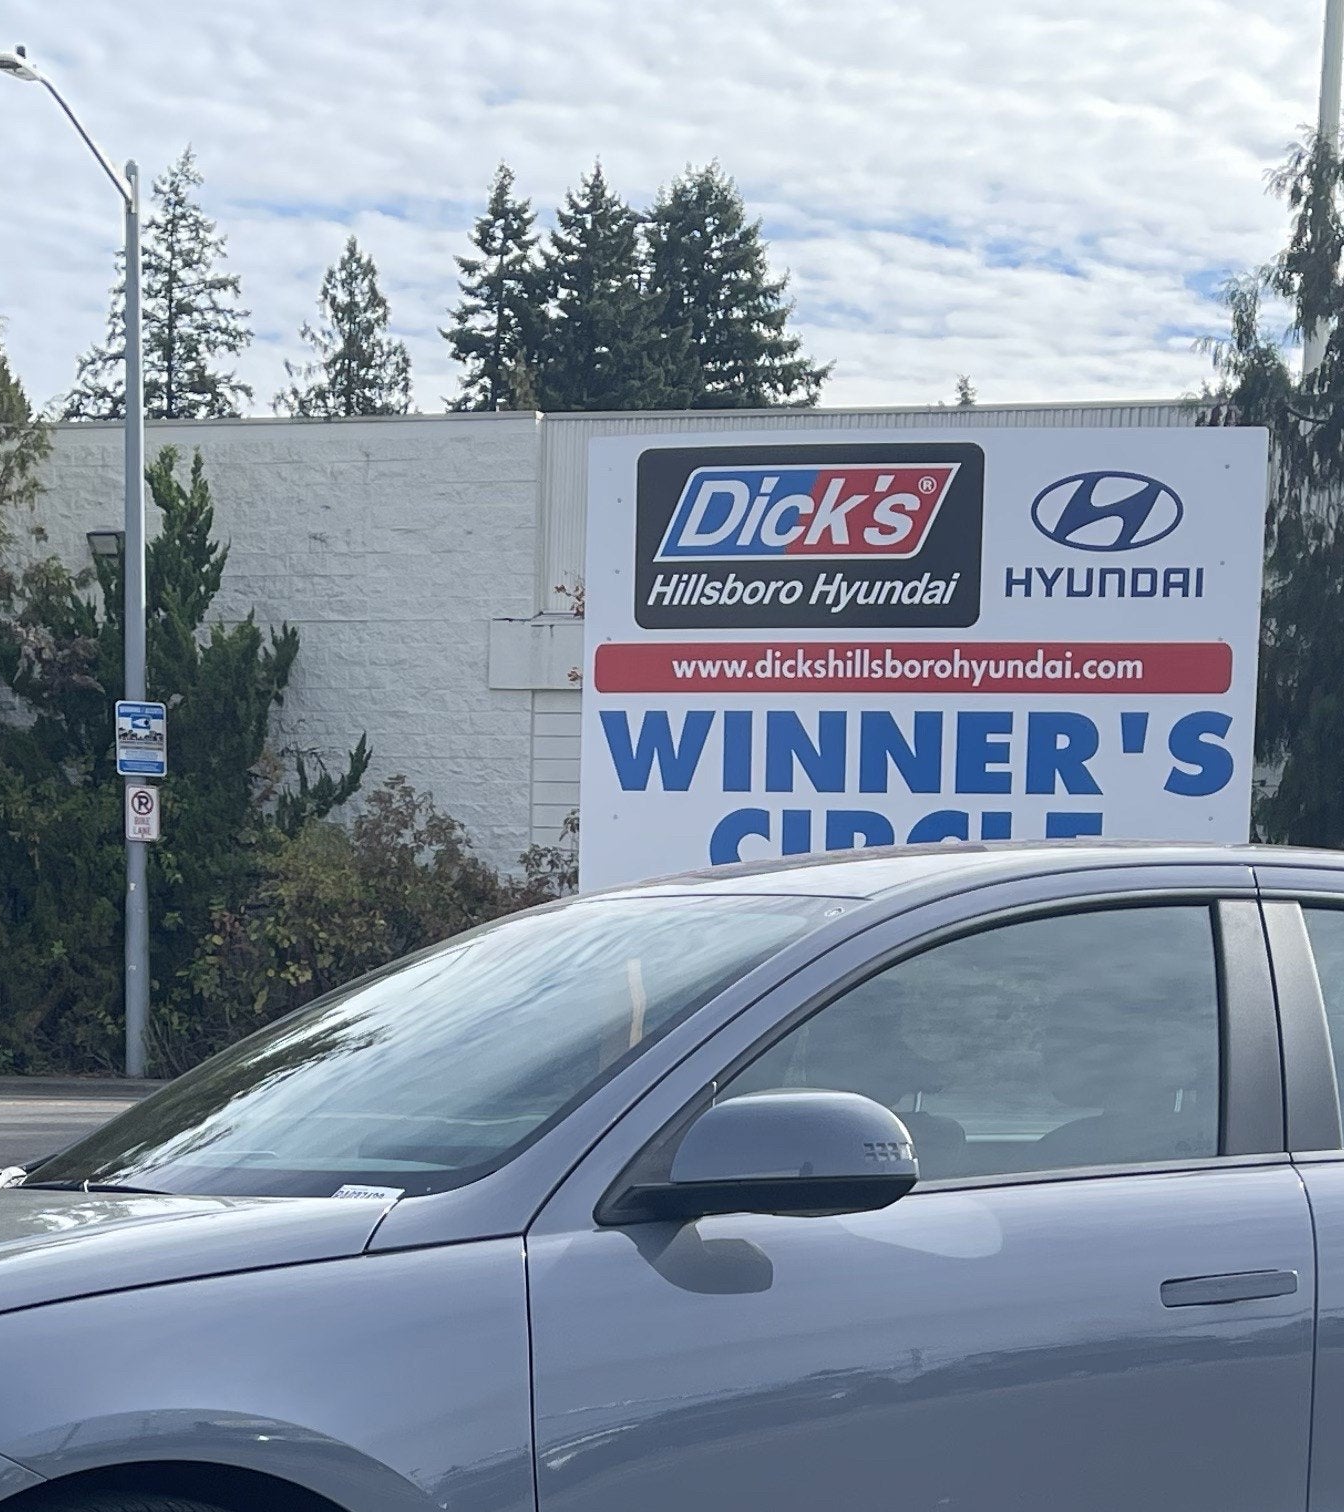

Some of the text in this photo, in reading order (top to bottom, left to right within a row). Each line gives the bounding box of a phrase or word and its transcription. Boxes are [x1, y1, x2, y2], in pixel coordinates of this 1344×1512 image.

[647, 572, 960, 614] Hillsboro Hyundai
[1005, 566, 1204, 599] HYUNDAI
[671, 649, 1144, 687] www.dickshillsborohyundai.com
[599, 710, 1234, 798] WINNER'S
